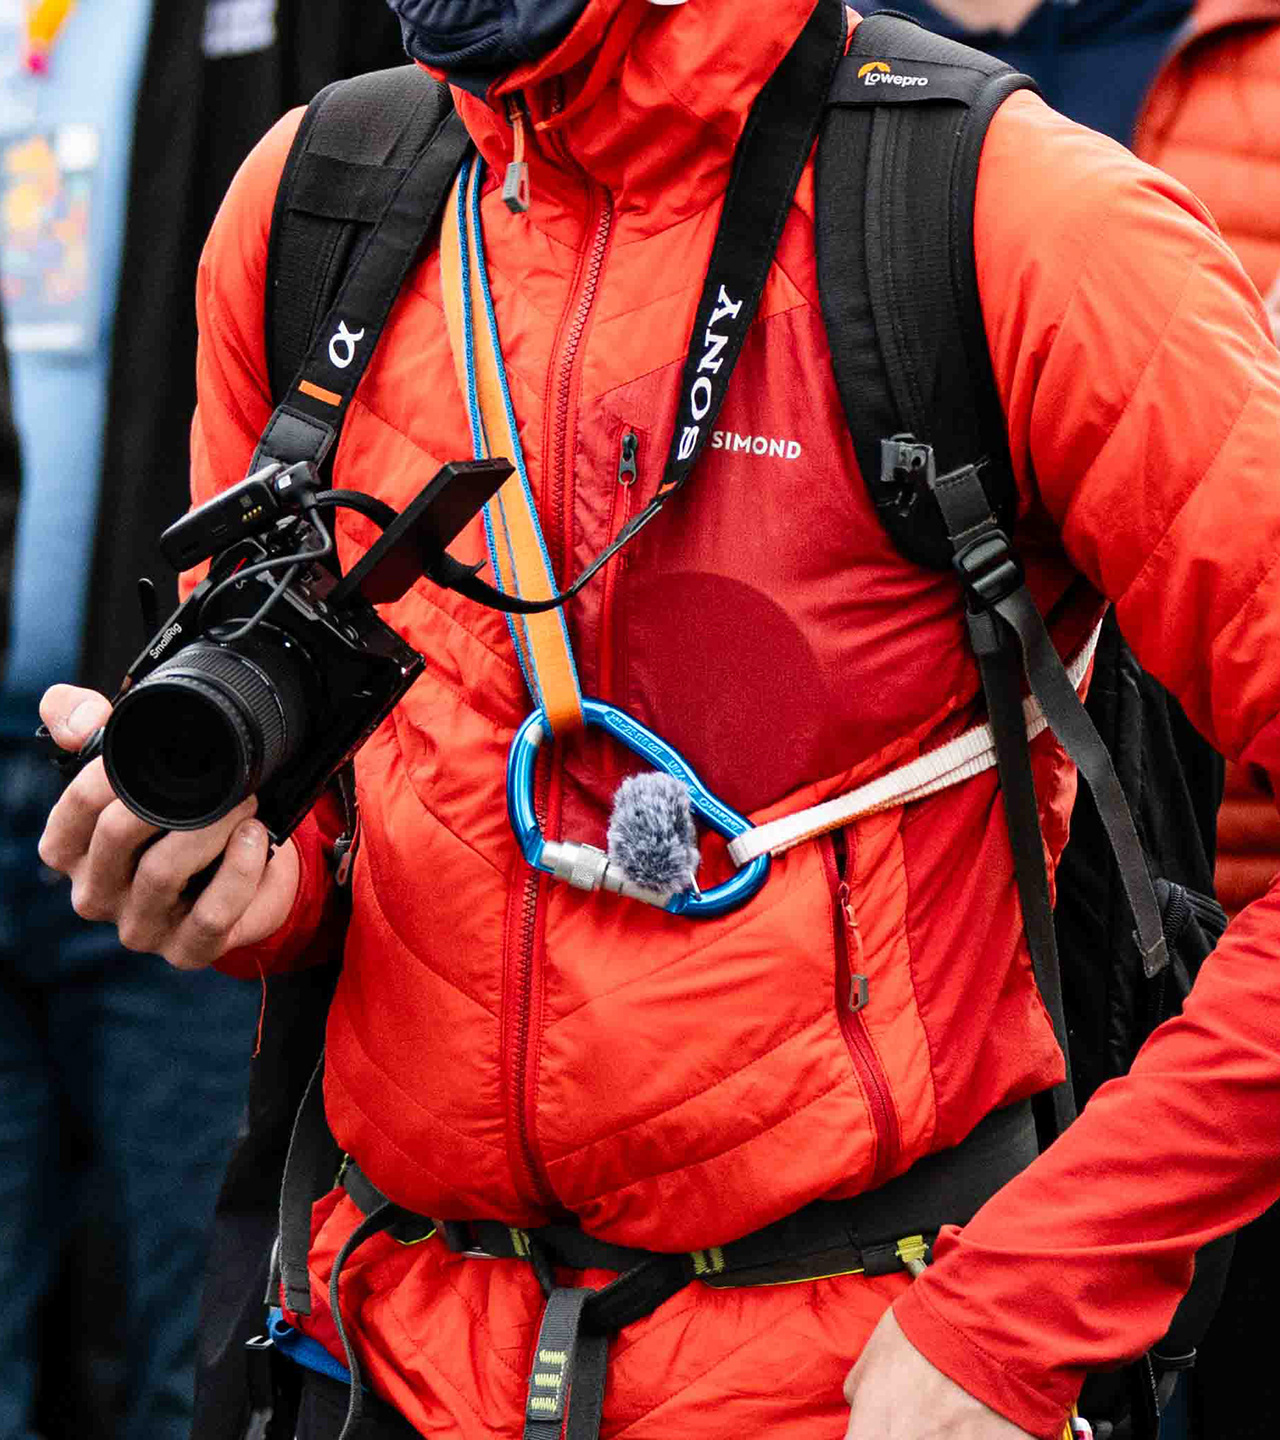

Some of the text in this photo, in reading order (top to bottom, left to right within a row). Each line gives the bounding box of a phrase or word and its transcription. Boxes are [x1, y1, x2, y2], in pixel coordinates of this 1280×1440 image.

[864, 72, 929, 88] Lowepro
[676, 284, 743, 461] SONY
[711, 430, 802, 459] SIMOND
[149, 622, 183, 659] SmallRig
